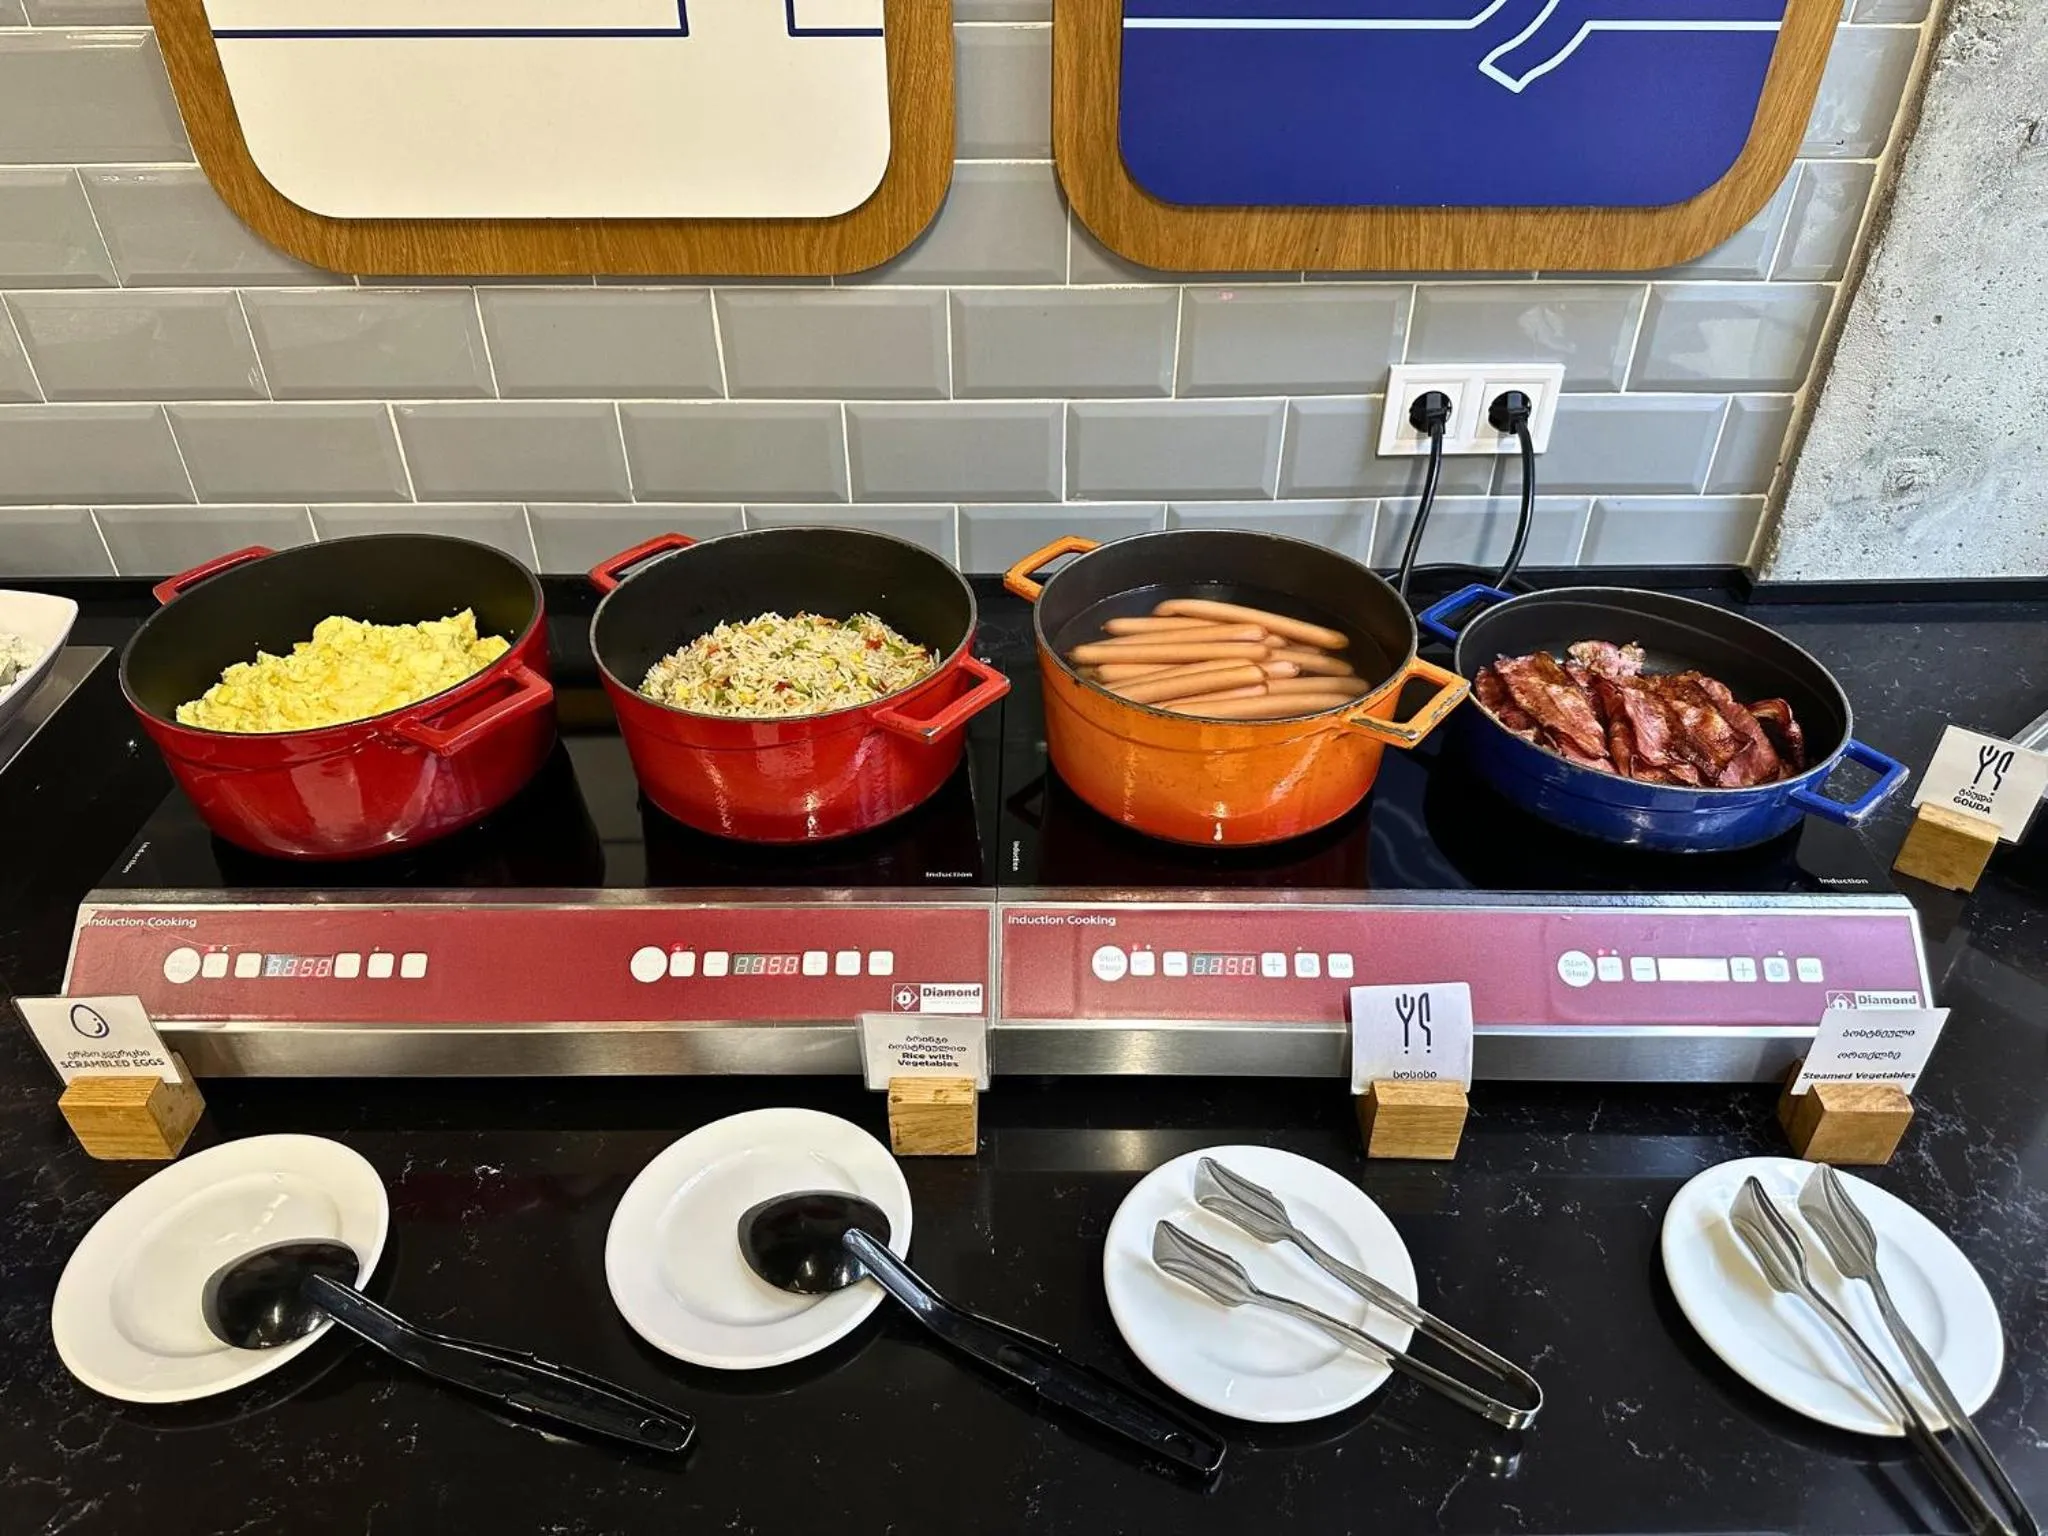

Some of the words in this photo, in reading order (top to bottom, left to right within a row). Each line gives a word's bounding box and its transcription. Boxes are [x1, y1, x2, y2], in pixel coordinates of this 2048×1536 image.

[1953, 796, 1991, 814] GOUDA
[88, 917, 144, 927] Induction
[147, 917, 197, 928] Cooking
[1008, 915, 1064, 925] Induction
[1067, 915, 1116, 926] Cooking
[923, 987, 980, 998] Diamond
[1858, 995, 1917, 1006] Diamond
[901, 1052, 926, 1060] Rice
[60, 1060, 130, 1069] SCRAMBLED
[133, 1059, 165, 1067] EGGS
[898, 1059, 960, 1067] Vegetables
[1802, 1072, 1853, 1080] Steamed
[1856, 1071, 1916, 1080] Vegetables
